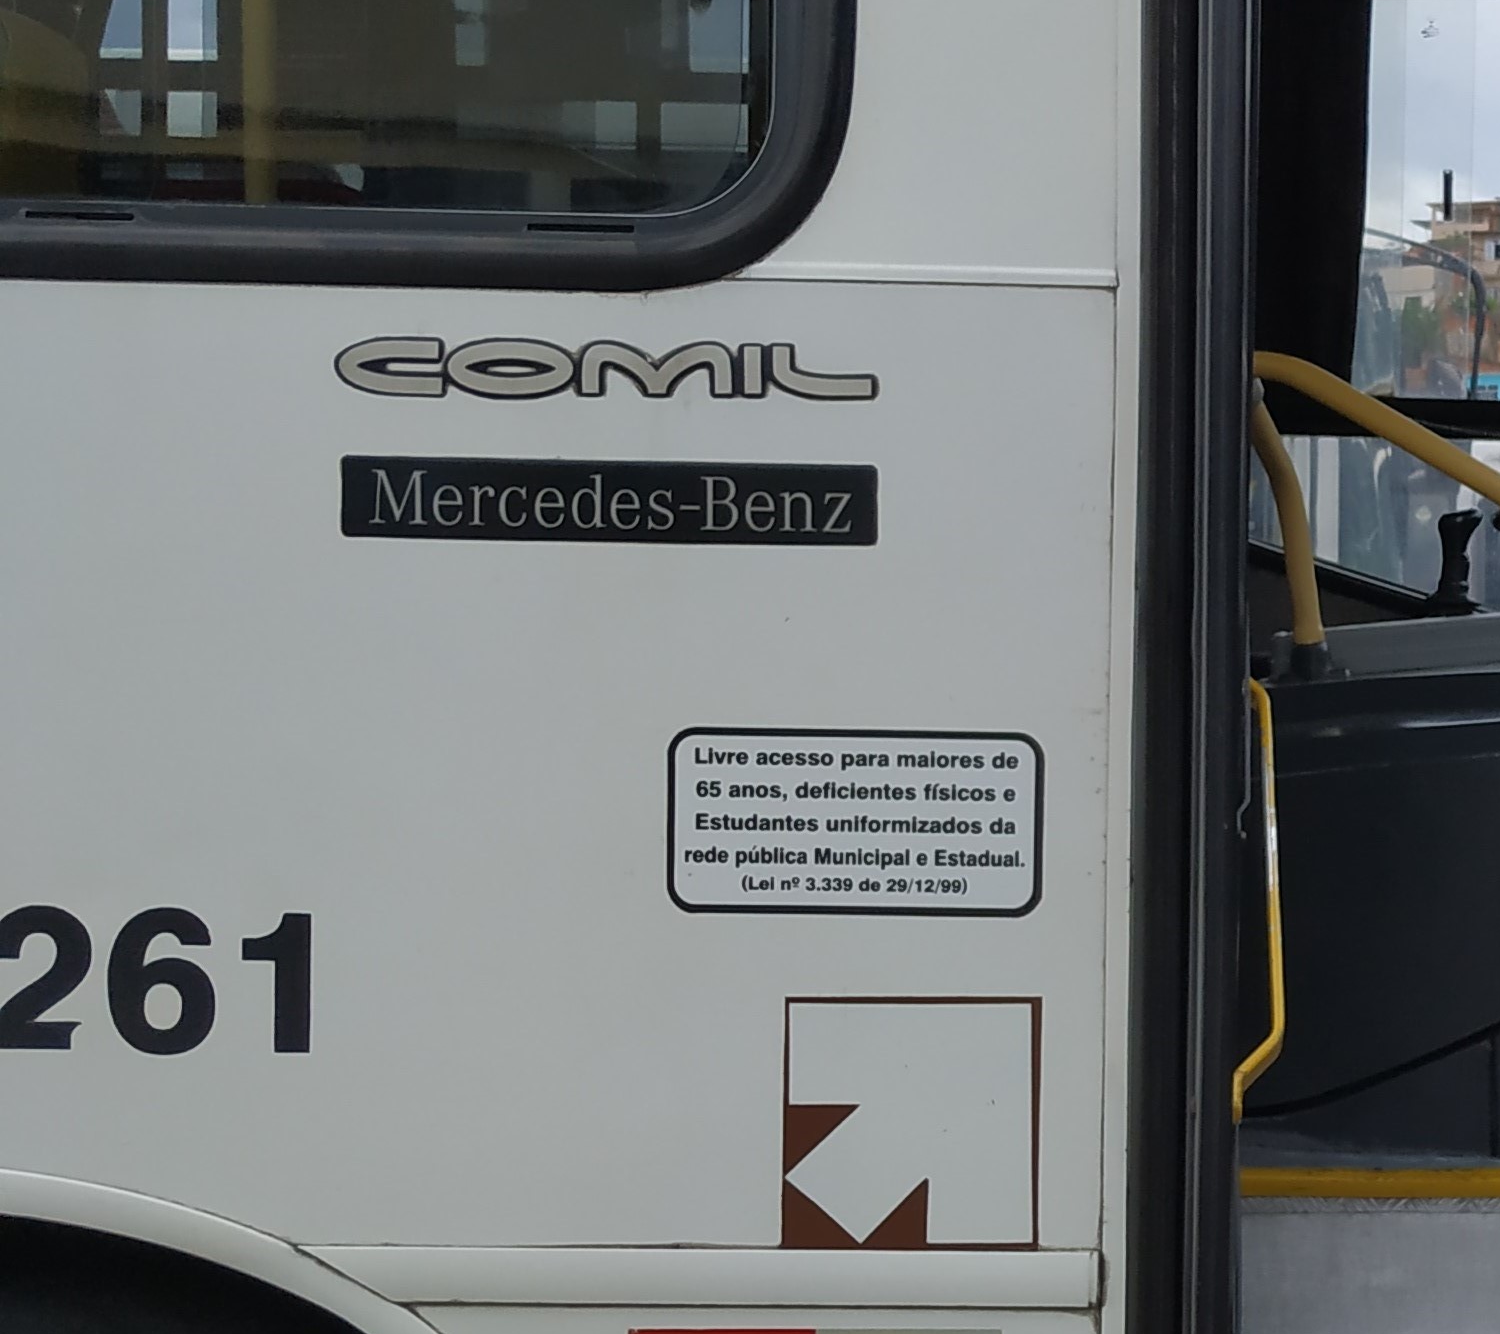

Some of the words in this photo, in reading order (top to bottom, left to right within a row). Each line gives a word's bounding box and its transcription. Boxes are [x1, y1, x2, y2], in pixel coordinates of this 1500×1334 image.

[334, 336, 881, 402] COMIL
[368, 468, 852, 534] Mercedes-Benz
[694, 747, 749, 766] Livre
[755, 751, 834, 768] acesso
[840, 752, 890, 771] para
[896, 750, 985, 769] maiores
[991, 751, 1019, 770] de
[695, 780, 722, 798] 65
[728, 783, 788, 802] anos,
[794, 781, 917, 801] deficientes
[923, 782, 997, 802] físicos
[1002, 787, 1016, 803] e
[695, 812, 819, 833] Estudantes
[825, 814, 983, 835] uniformizados
[989, 817, 1016, 835] da
[684, 845, 729, 864] rede
[735, 844, 808, 869] pública
[814, 847, 911, 871] Municipal
[916, 851, 929, 868] e
[934, 849, 1026, 869] Estadual.
[741, 874, 775, 893] (Lei
[805, 877, 854, 892] 3.339
[858, 877, 881, 893] de
[886, 877, 968, 895] 29/12/99)
[0, 904, 311, 1056] 261
